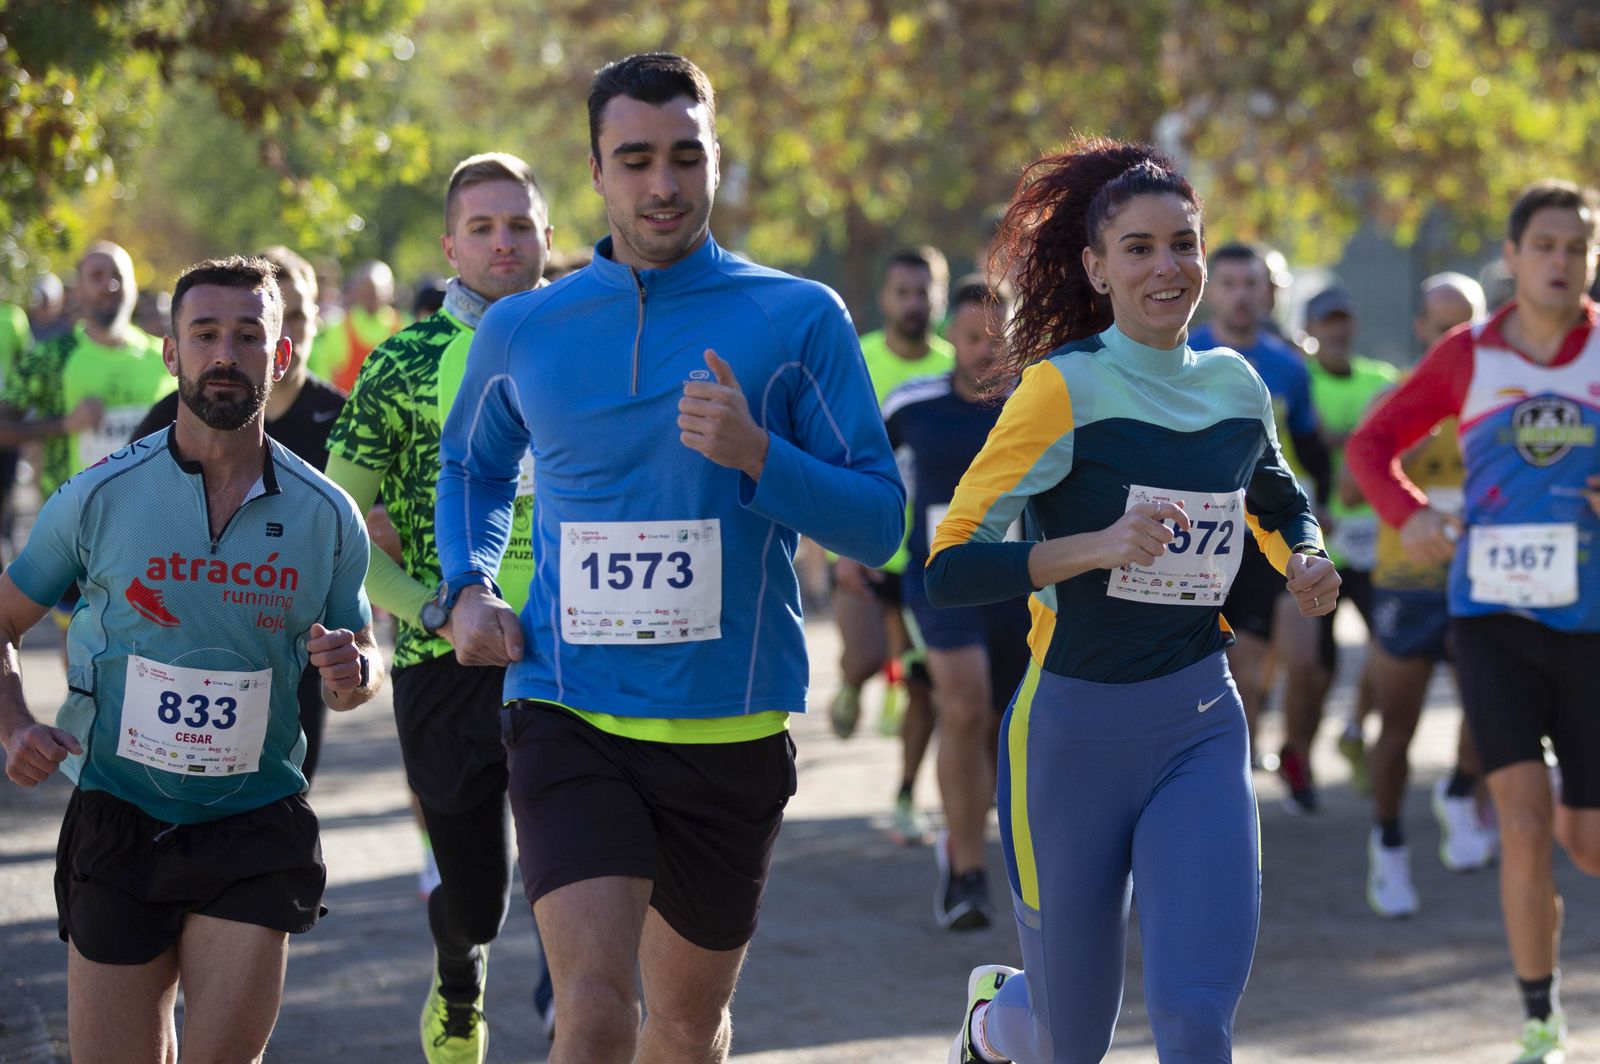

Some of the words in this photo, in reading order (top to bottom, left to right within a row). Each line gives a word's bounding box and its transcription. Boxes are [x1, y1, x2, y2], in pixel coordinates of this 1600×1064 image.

[1160, 519, 1234, 554] 572
[145, 551, 299, 592] atracón
[582, 551, 694, 590] 1573
[1488, 544, 1557, 571] 1367
[222, 589, 294, 611] running
[158, 691, 237, 730] 833
[175, 731, 213, 744] CESAR
